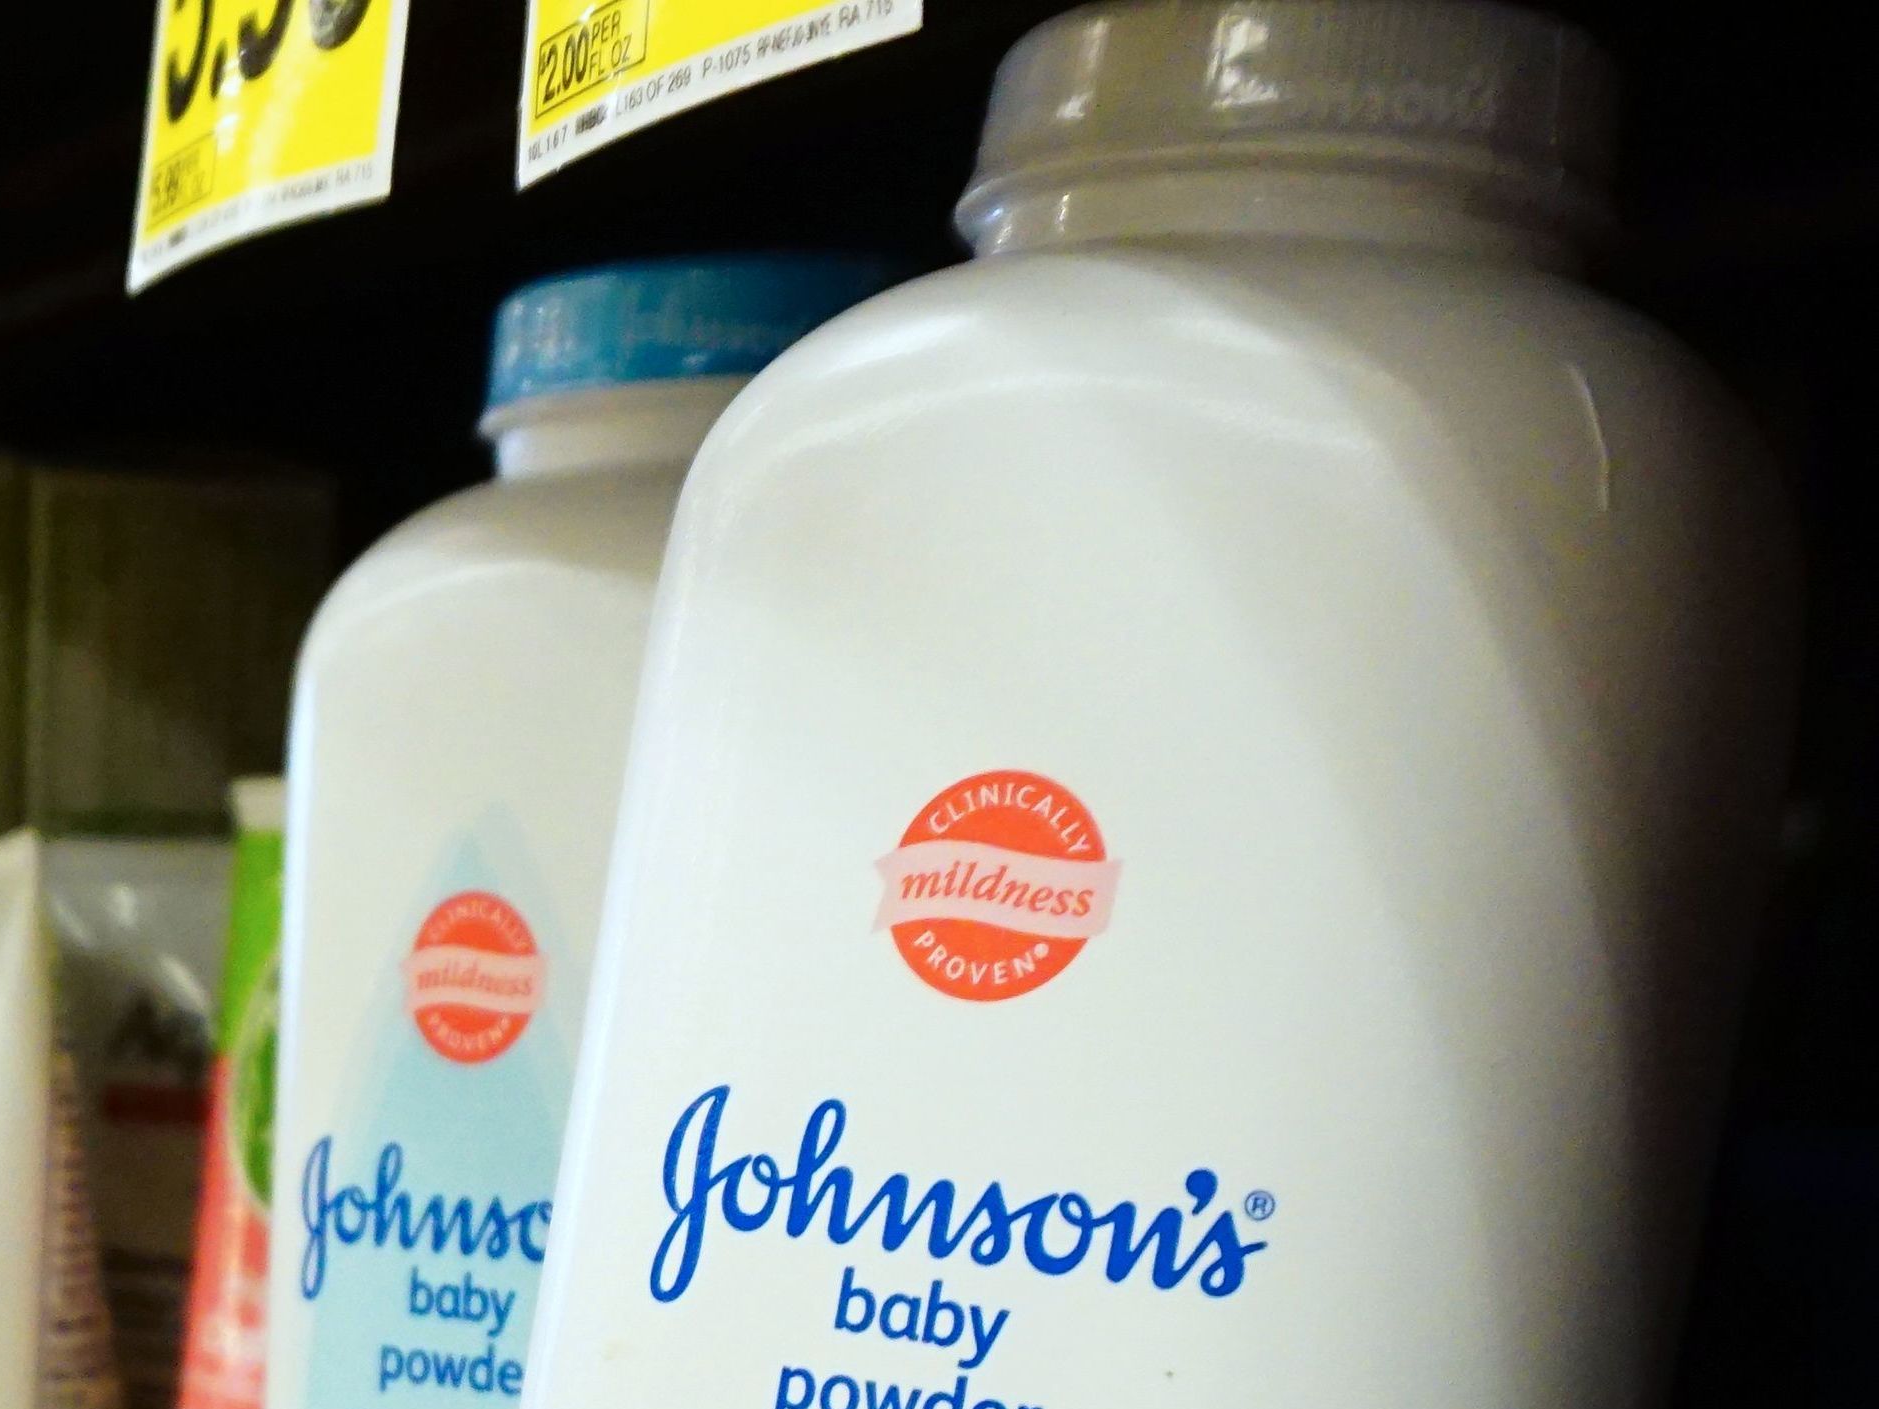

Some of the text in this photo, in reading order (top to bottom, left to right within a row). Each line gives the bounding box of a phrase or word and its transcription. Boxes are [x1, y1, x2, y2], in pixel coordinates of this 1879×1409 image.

[589, 32, 632, 80] FL OZ
[591, 9, 621, 49] PER
[646, 75, 664, 100] OF
[928, 783, 1091, 855] CLINICALLY
[901, 860, 1095, 917] mildness
[301, 1135, 554, 1301] Johnso
[410, 1265, 516, 1337] baby
[834, 1266, 1010, 1369] baby
[379, 1341, 525, 1396] powde
